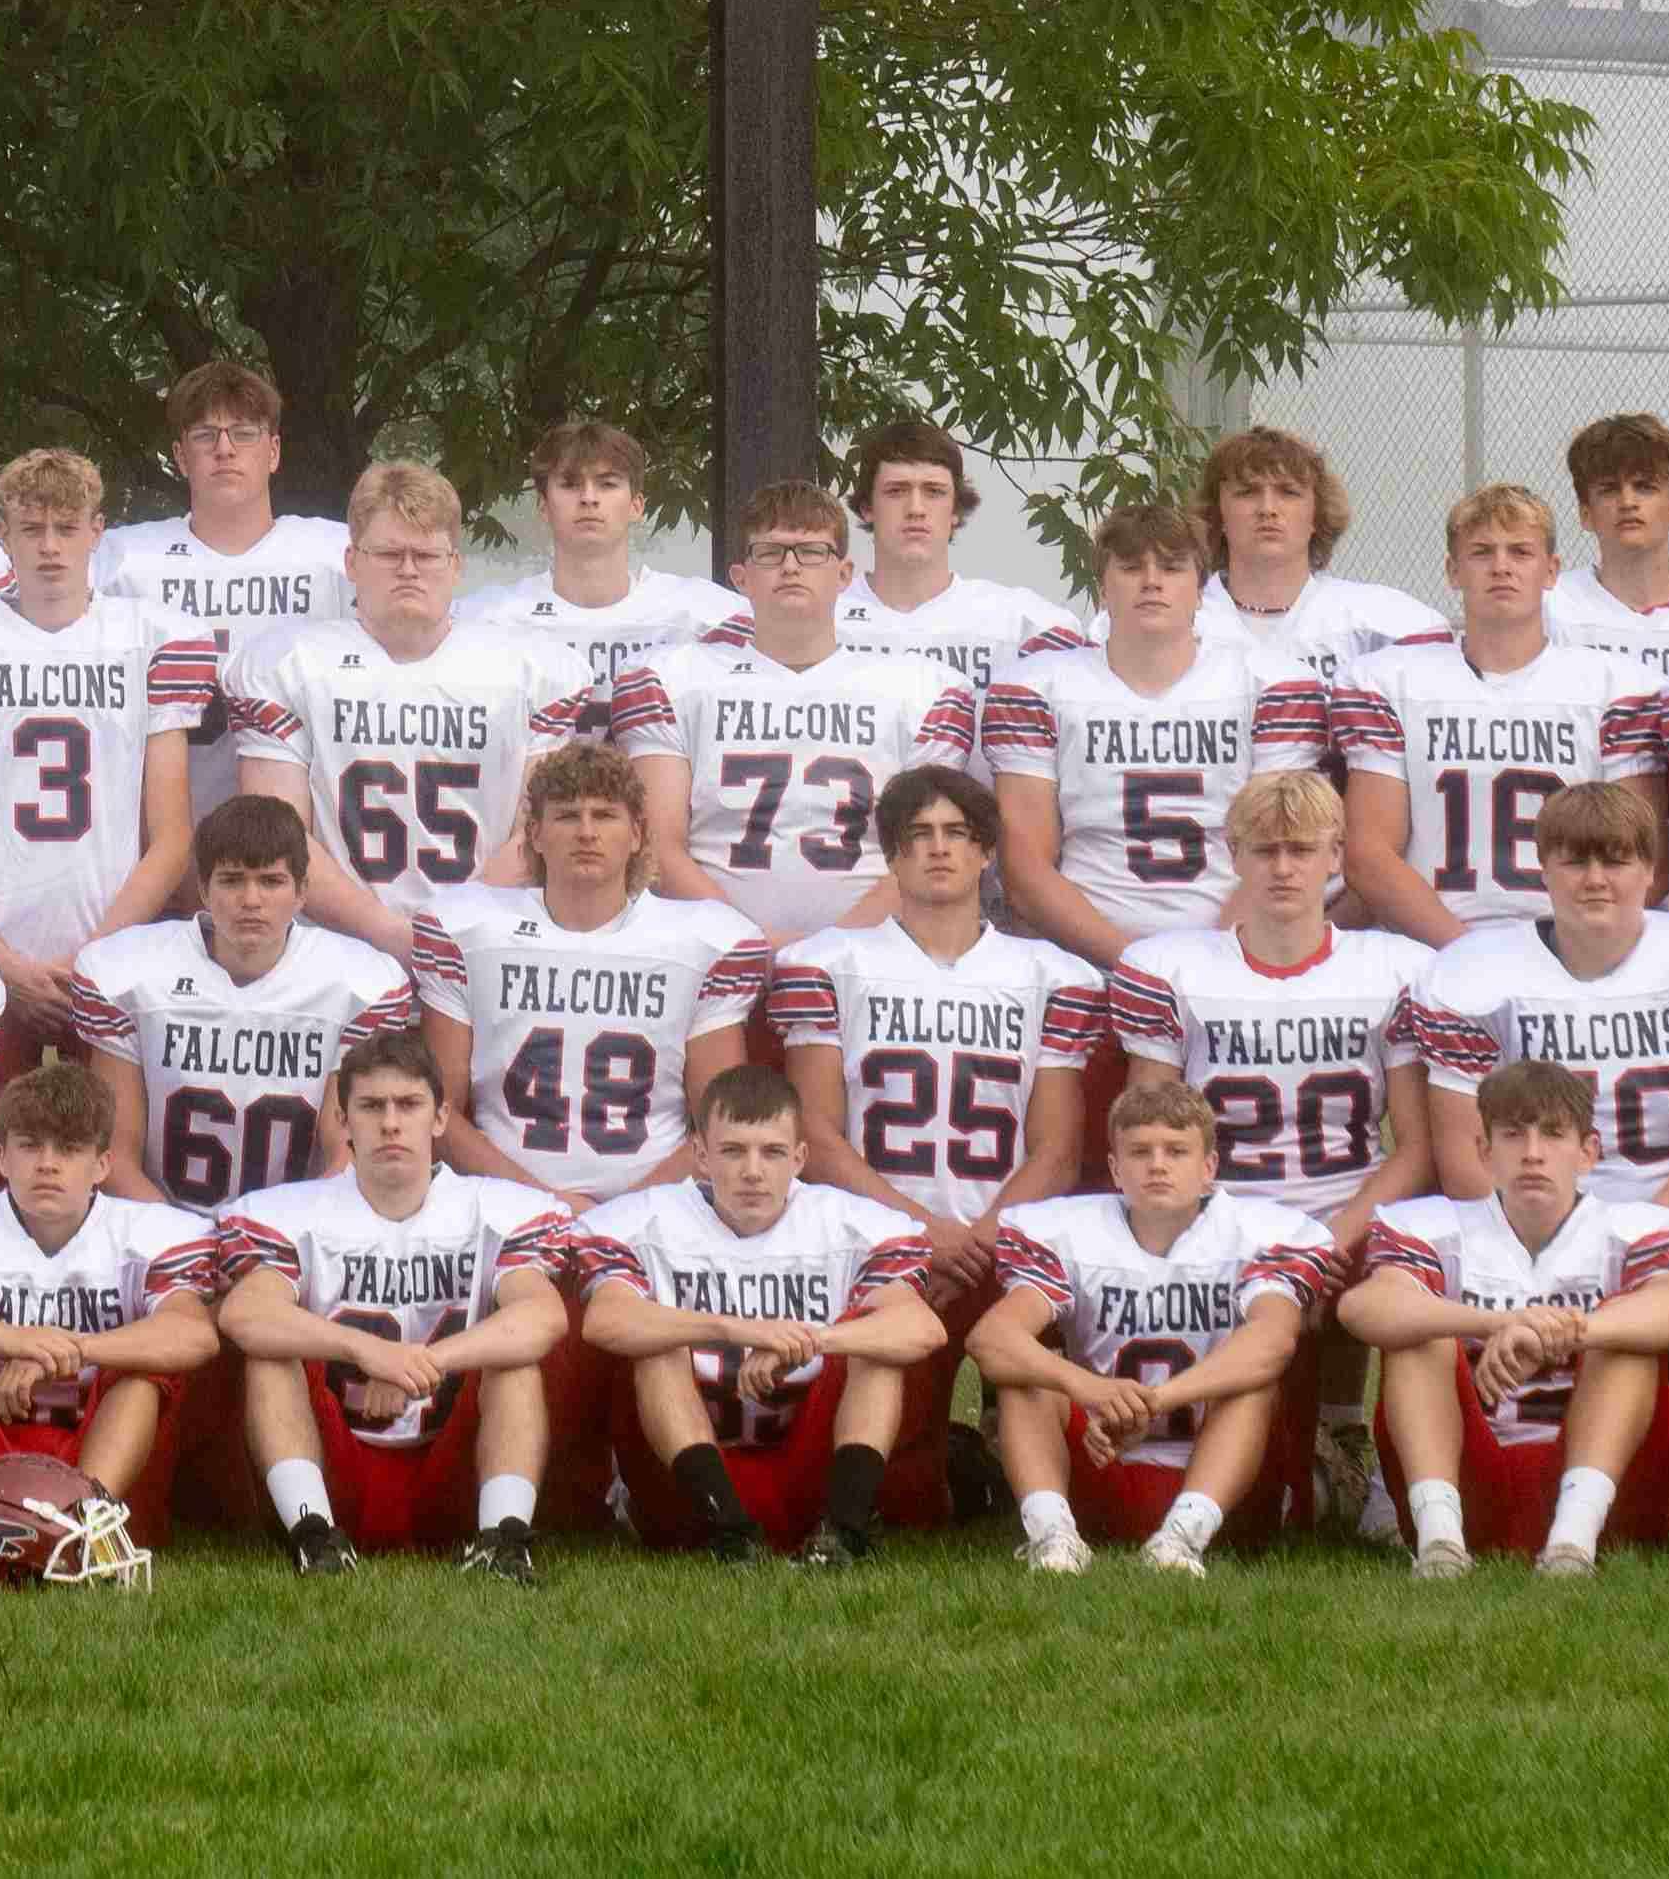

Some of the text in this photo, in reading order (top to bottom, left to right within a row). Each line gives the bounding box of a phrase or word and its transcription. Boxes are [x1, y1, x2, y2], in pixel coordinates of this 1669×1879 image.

[161, 574, 311, 618] FALCONS
[332, 697, 488, 751] FALCONS
[714, 698, 878, 747] FALCONS
[1085, 718, 1239, 765] FALCONS
[1426, 717, 1576, 766] FALCONS
[11, 715, 93, 843] 3
[337, 757, 482, 885] 65
[719, 752, 876, 872] 73
[1122, 769, 1208, 884] 5
[500, 962, 668, 1019] FALCONS
[161, 1022, 324, 1079] FALCONS
[867, 995, 1024, 1053] FALCONS
[1204, 1017, 1370, 1067] FALCONS
[502, 1025, 658, 1156] 48
[860, 1047, 1023, 1182] 25
[161, 1085, 322, 1208] 60
[1203, 1068, 1375, 1183] 20
[672, 1270, 830, 1322] FALCONS
[1096, 1281, 1233, 1336] FACONS
